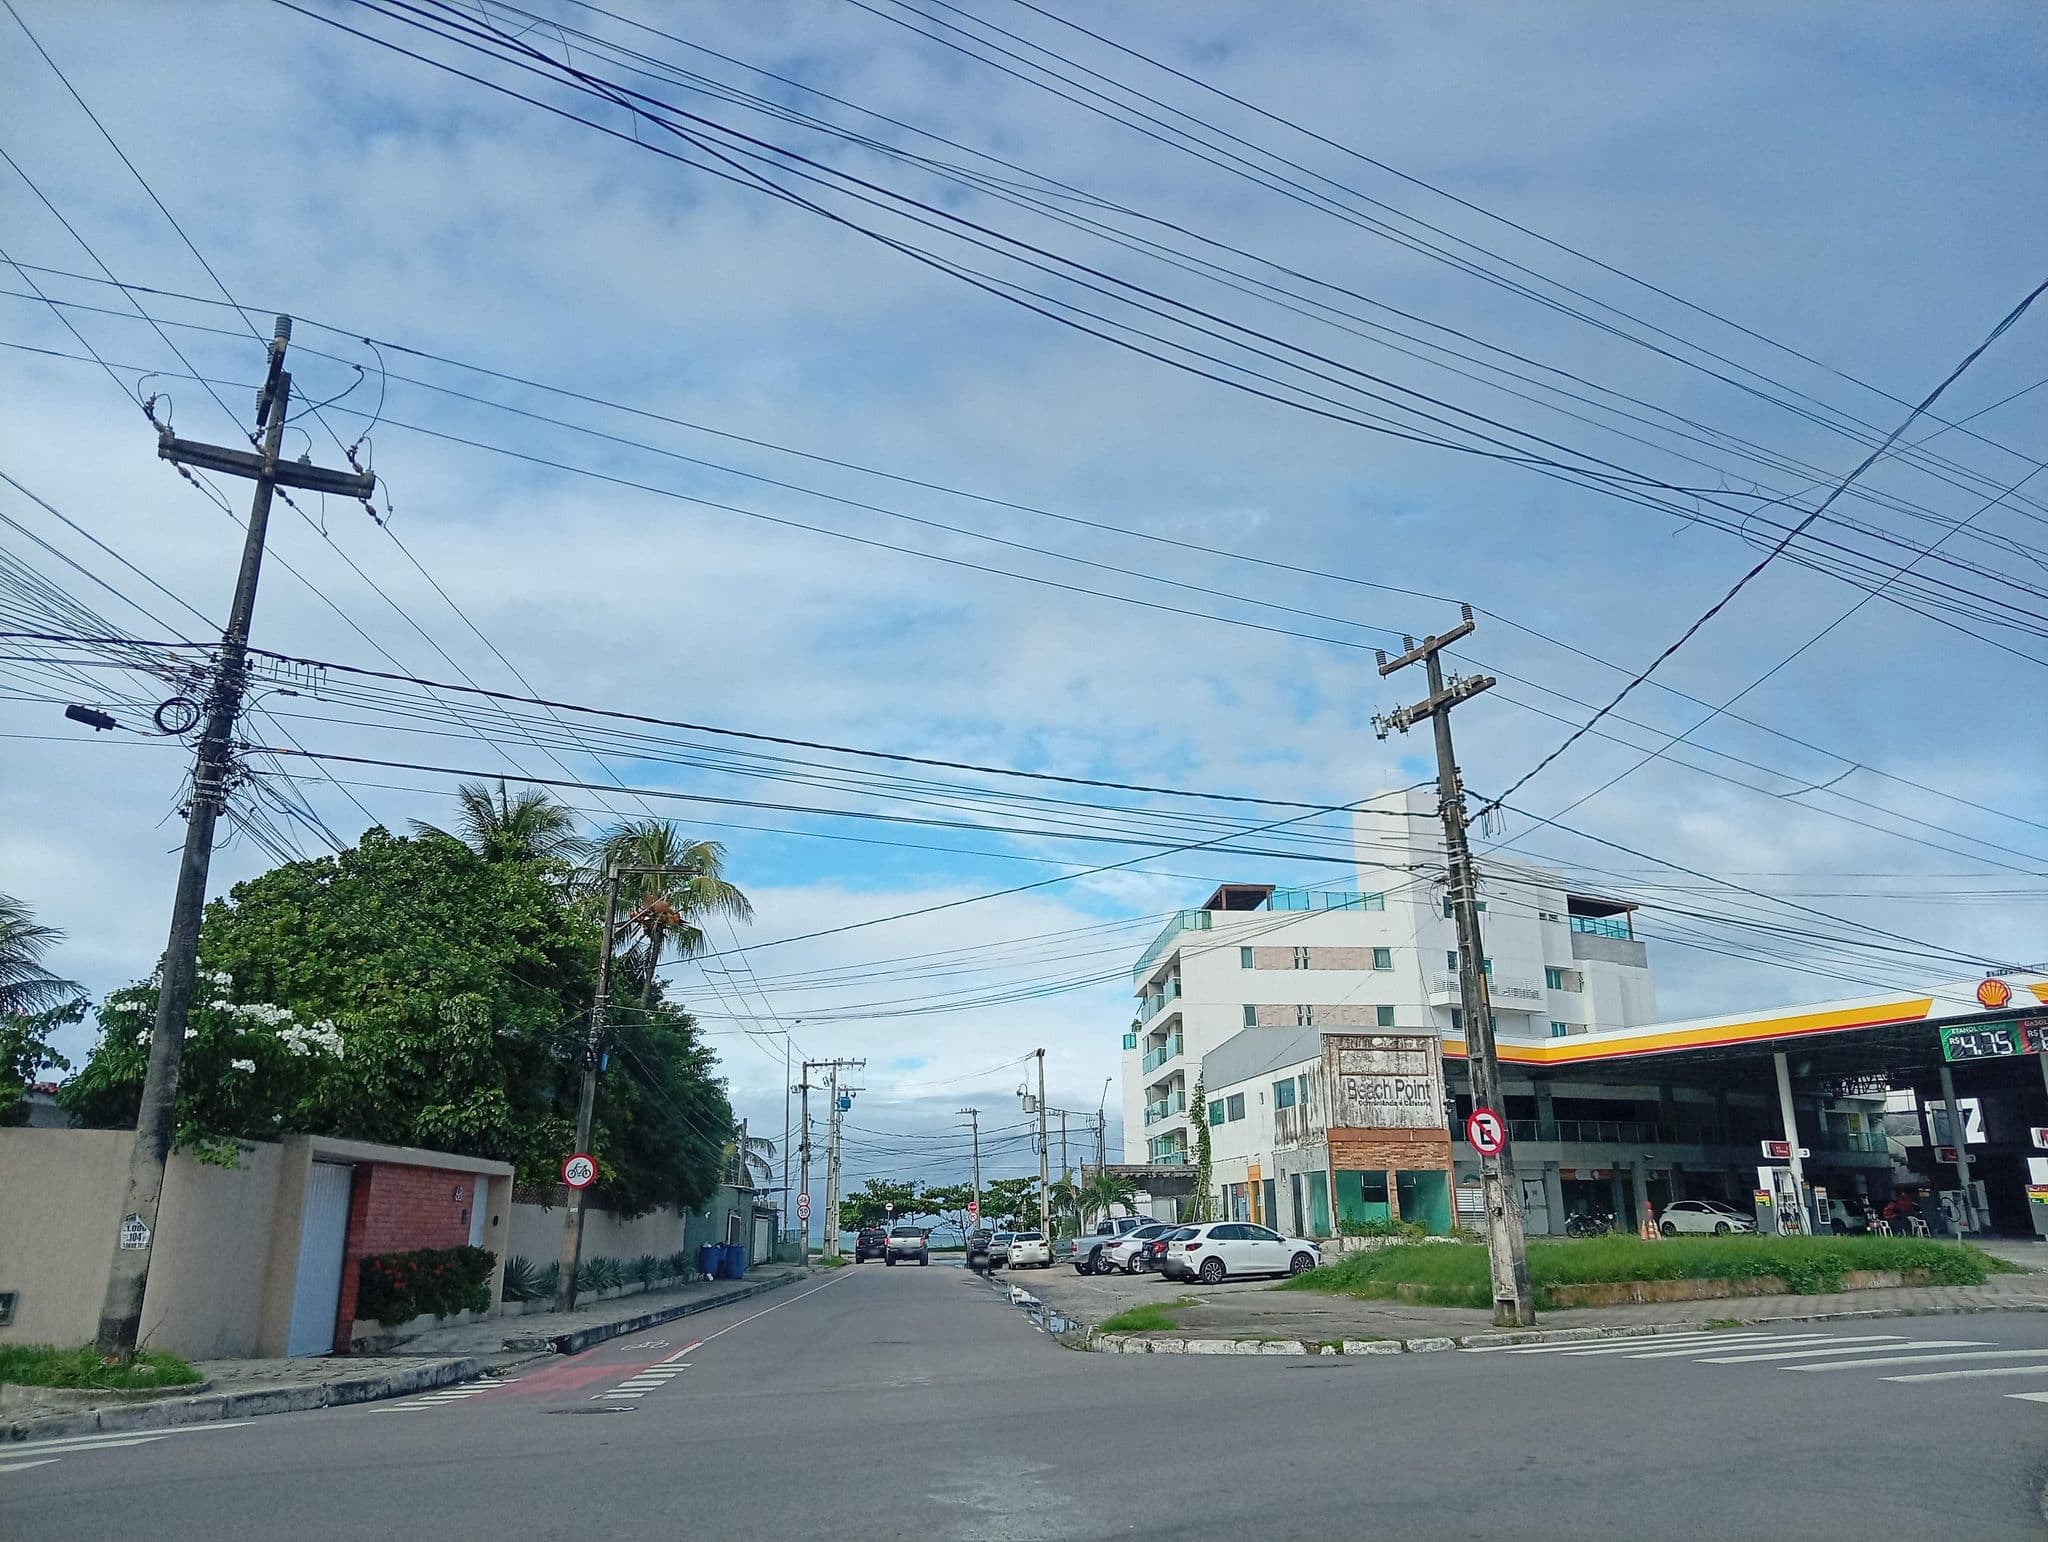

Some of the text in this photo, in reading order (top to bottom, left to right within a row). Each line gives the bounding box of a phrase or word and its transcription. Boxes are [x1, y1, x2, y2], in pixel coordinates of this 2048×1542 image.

[1949, 1031, 2013, 1055] R$ 4.75
[1348, 1078, 1431, 1100] Beach Point
[1478, 1119, 1494, 1144] E
